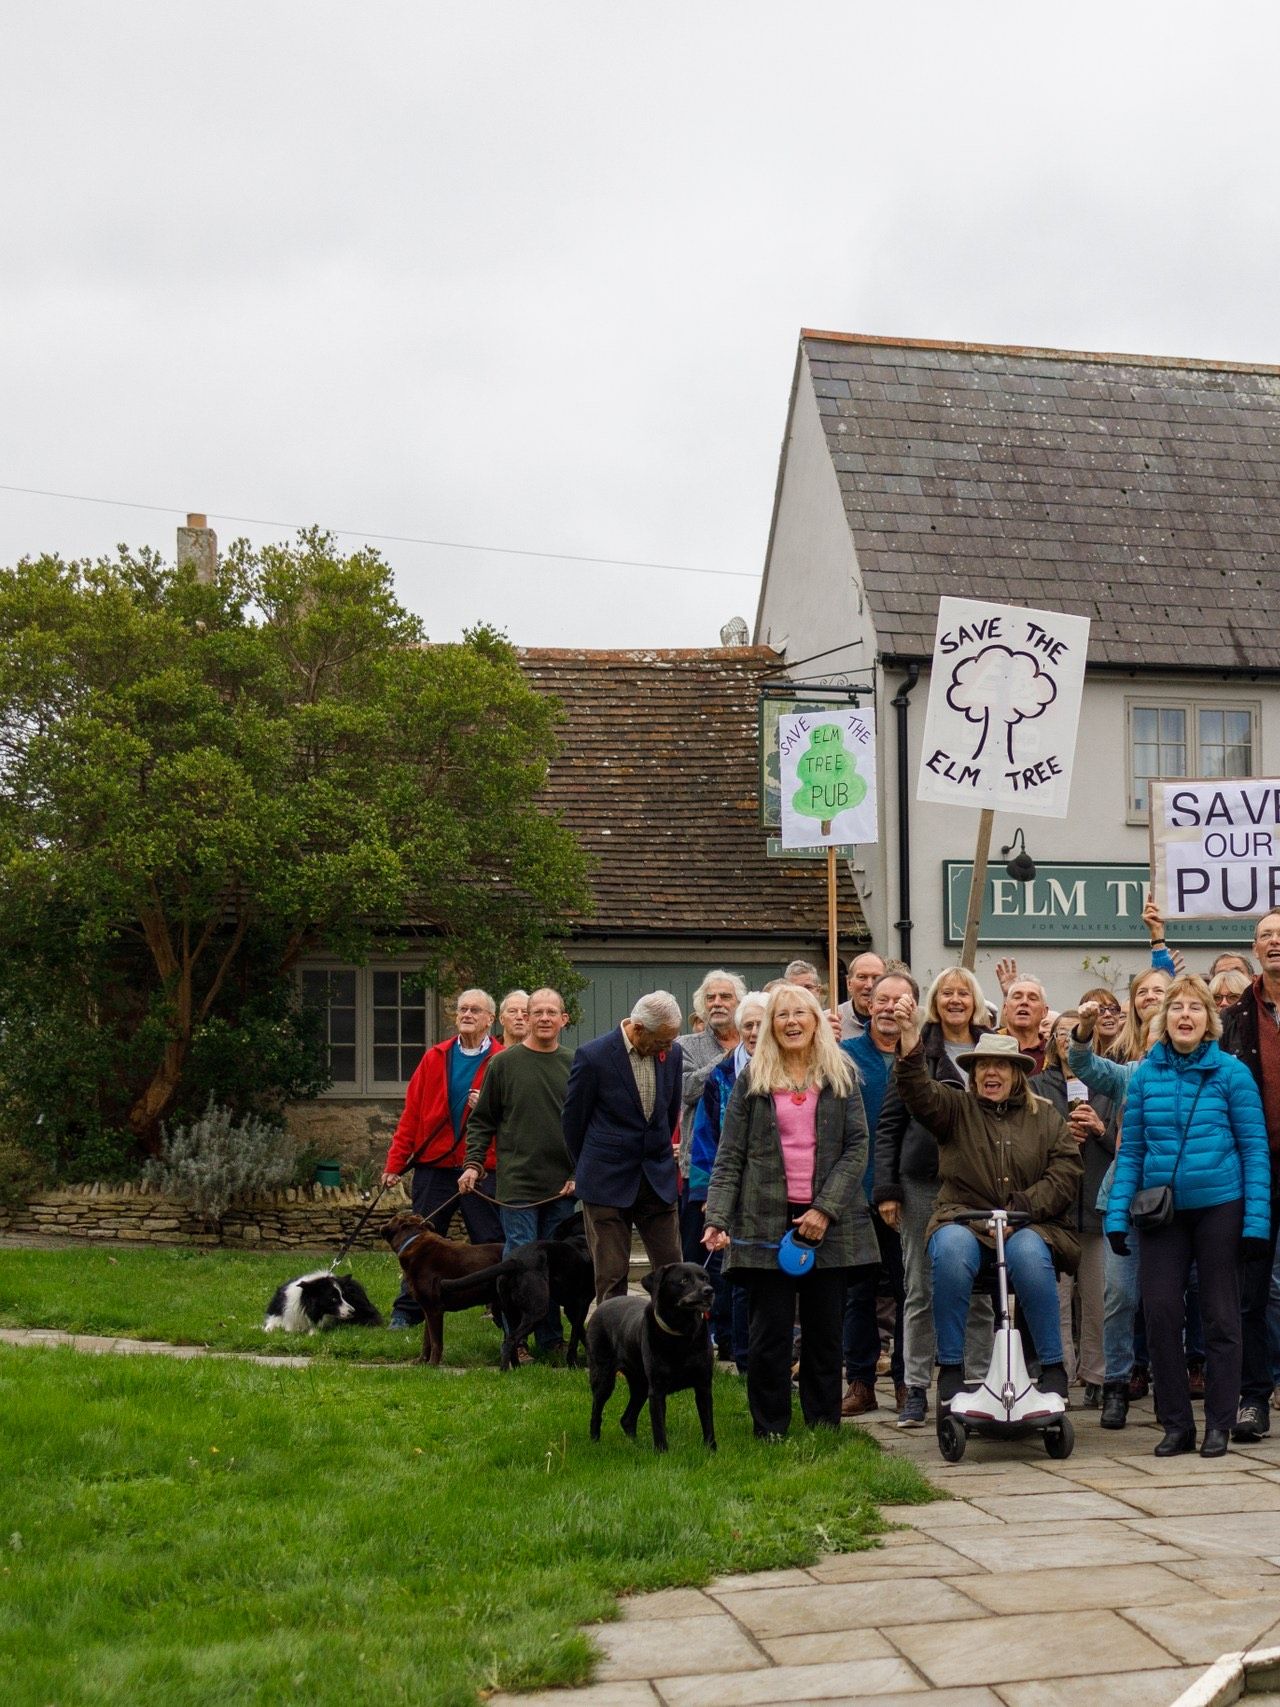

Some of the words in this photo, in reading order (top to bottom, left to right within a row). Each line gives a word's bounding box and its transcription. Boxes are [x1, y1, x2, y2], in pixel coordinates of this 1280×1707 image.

[940, 617, 1002, 654] SAVE
[1025, 622, 1070, 665] THE
[780, 716, 811, 756] SAVE
[847, 715, 872, 745] THE
[813, 728, 840, 744] ELM
[805, 753, 843, 773] TREE
[926, 749, 981, 788] ELM
[1005, 755, 1063, 792] TREE
[811, 782, 849, 809] PUB
[1204, 832, 1273, 859] OUR
[991, 878, 1088, 917] ELM
[1062, 924, 1122, 932] WALKERS,
